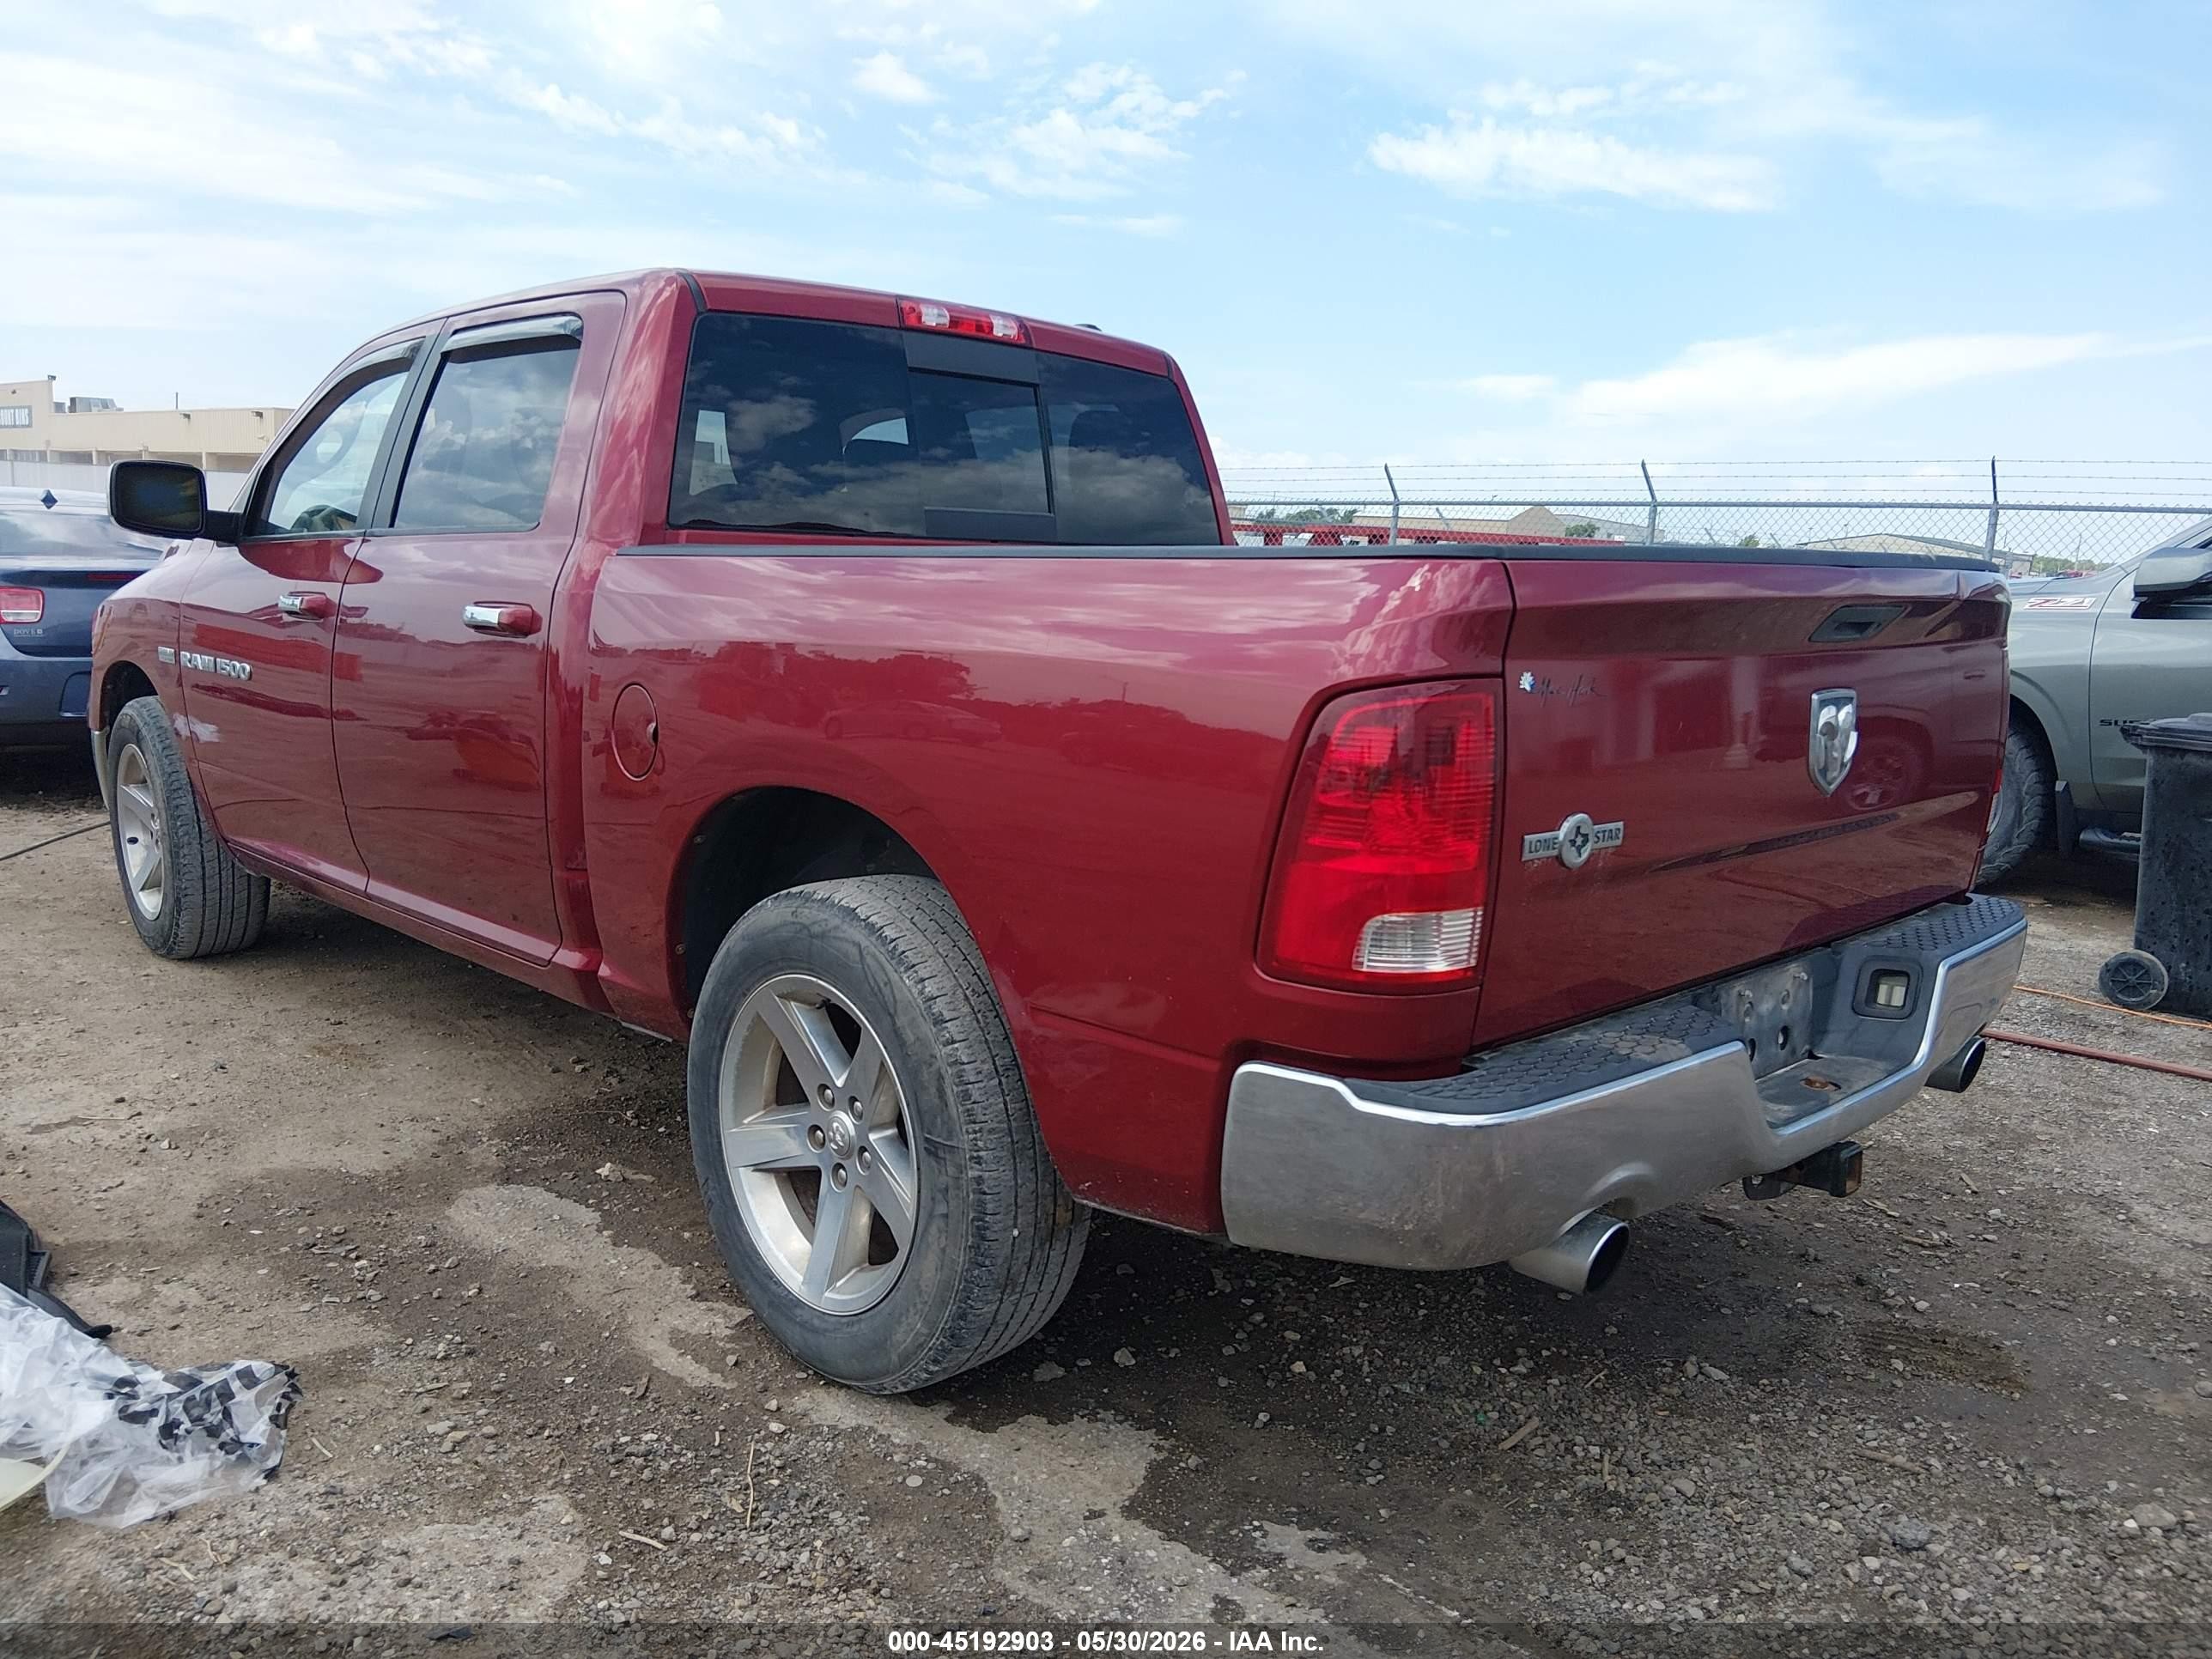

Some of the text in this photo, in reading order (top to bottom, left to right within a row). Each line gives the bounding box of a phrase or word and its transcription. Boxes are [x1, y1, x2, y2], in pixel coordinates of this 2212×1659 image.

[179, 650, 215, 673] RAM
[216, 656, 252, 681] 1500
[1528, 827, 1621, 854] LONE STAR
